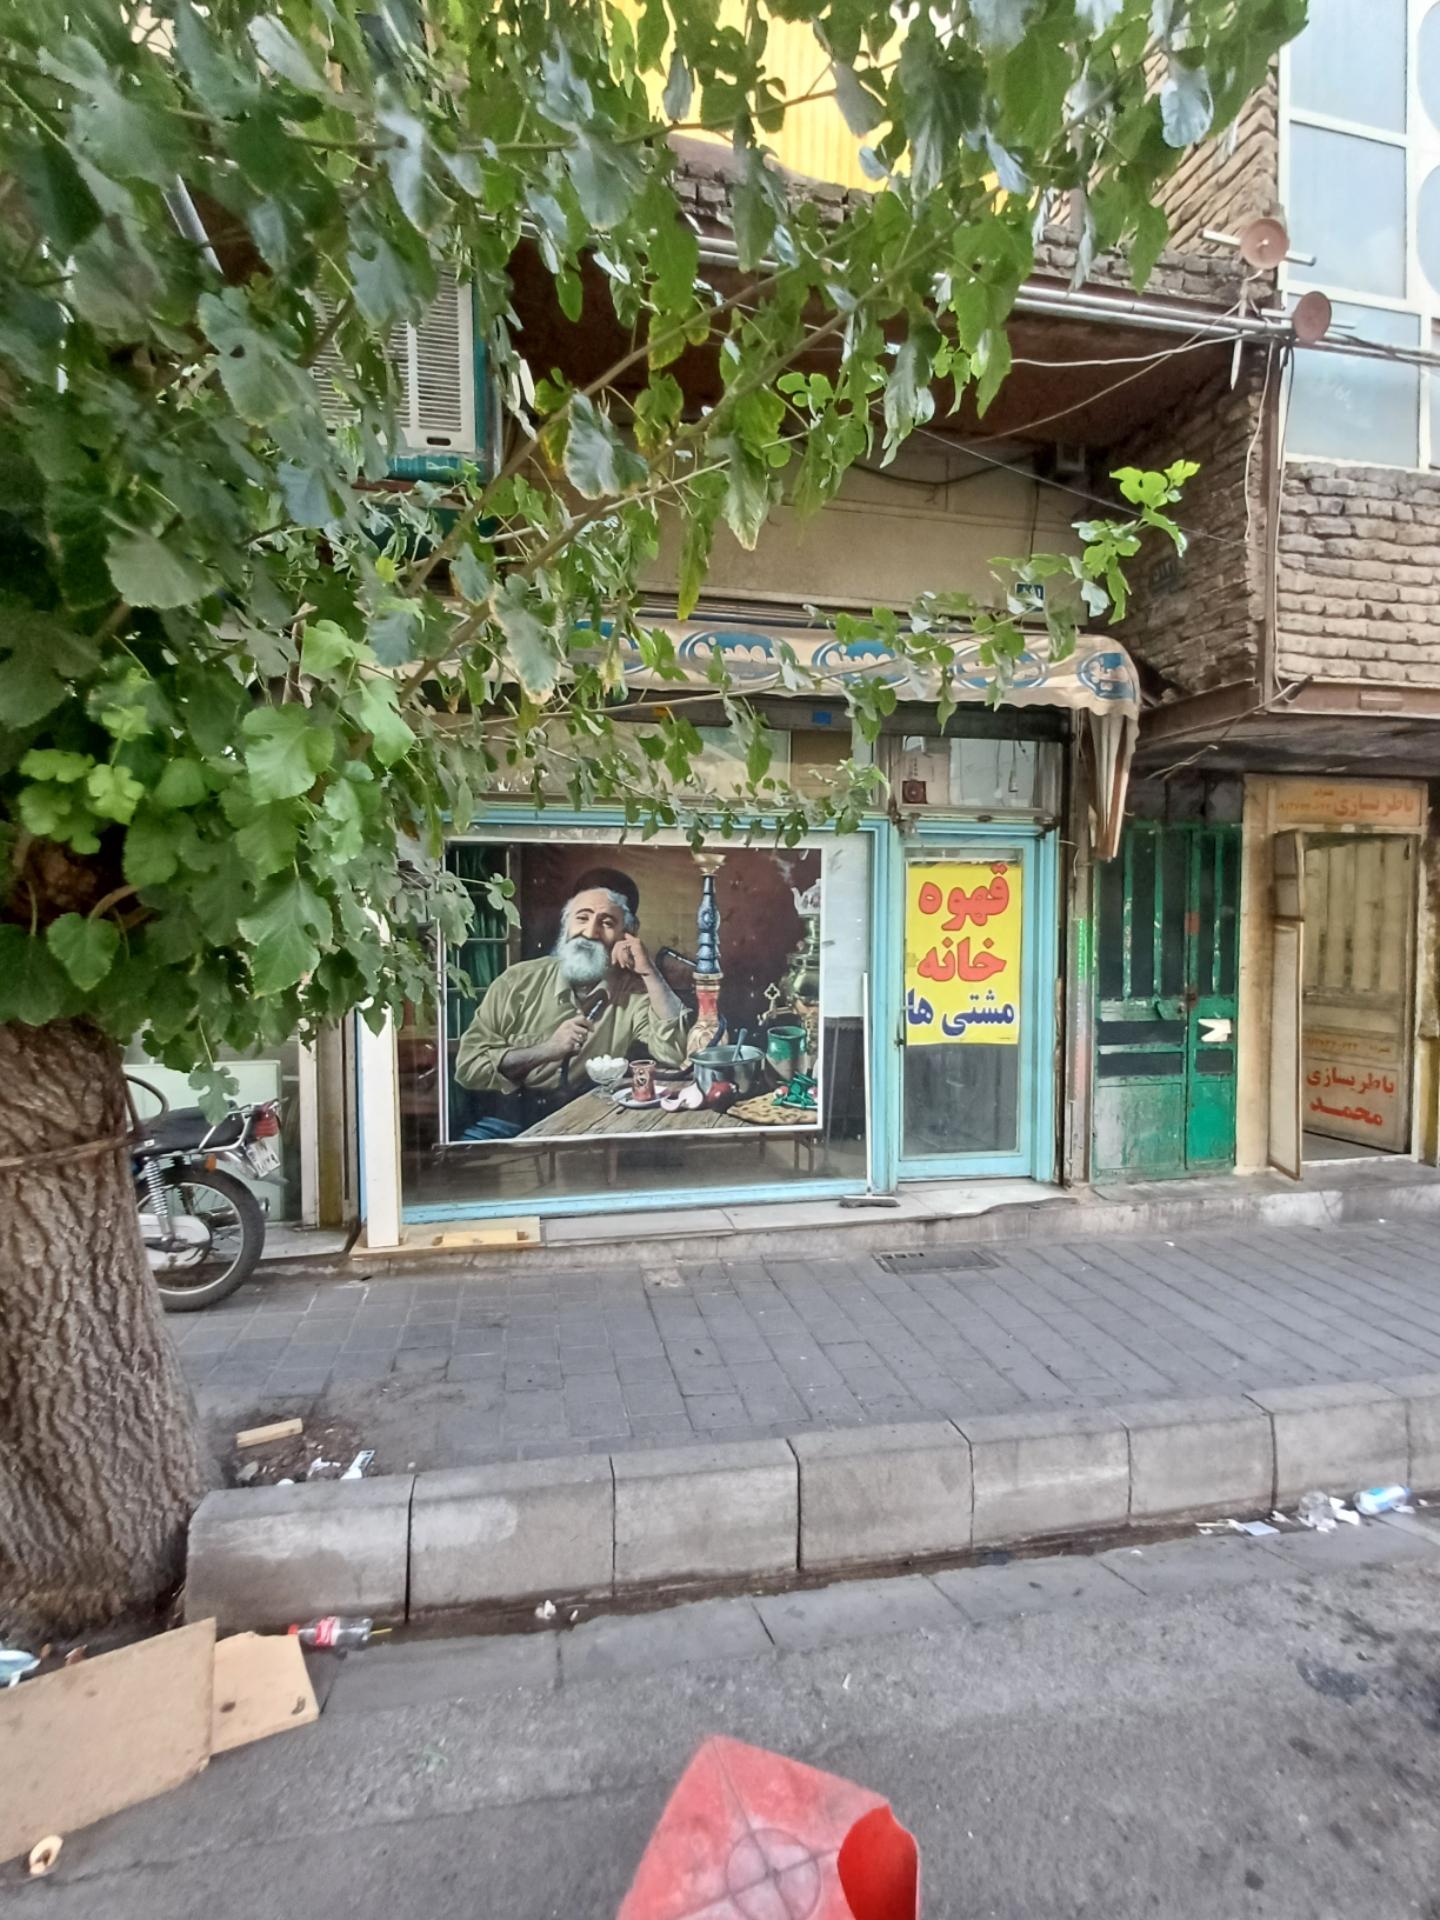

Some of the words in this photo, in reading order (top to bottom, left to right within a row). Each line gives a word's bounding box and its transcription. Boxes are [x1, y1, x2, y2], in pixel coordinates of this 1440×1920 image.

[918, 863, 1010, 931] قهوه
[917, 936, 1007, 982] خانه
[907, 988, 934, 1025] ها
[942, 989, 1015, 1036] مشتی
[1309, 1097, 1383, 1126] محمد
